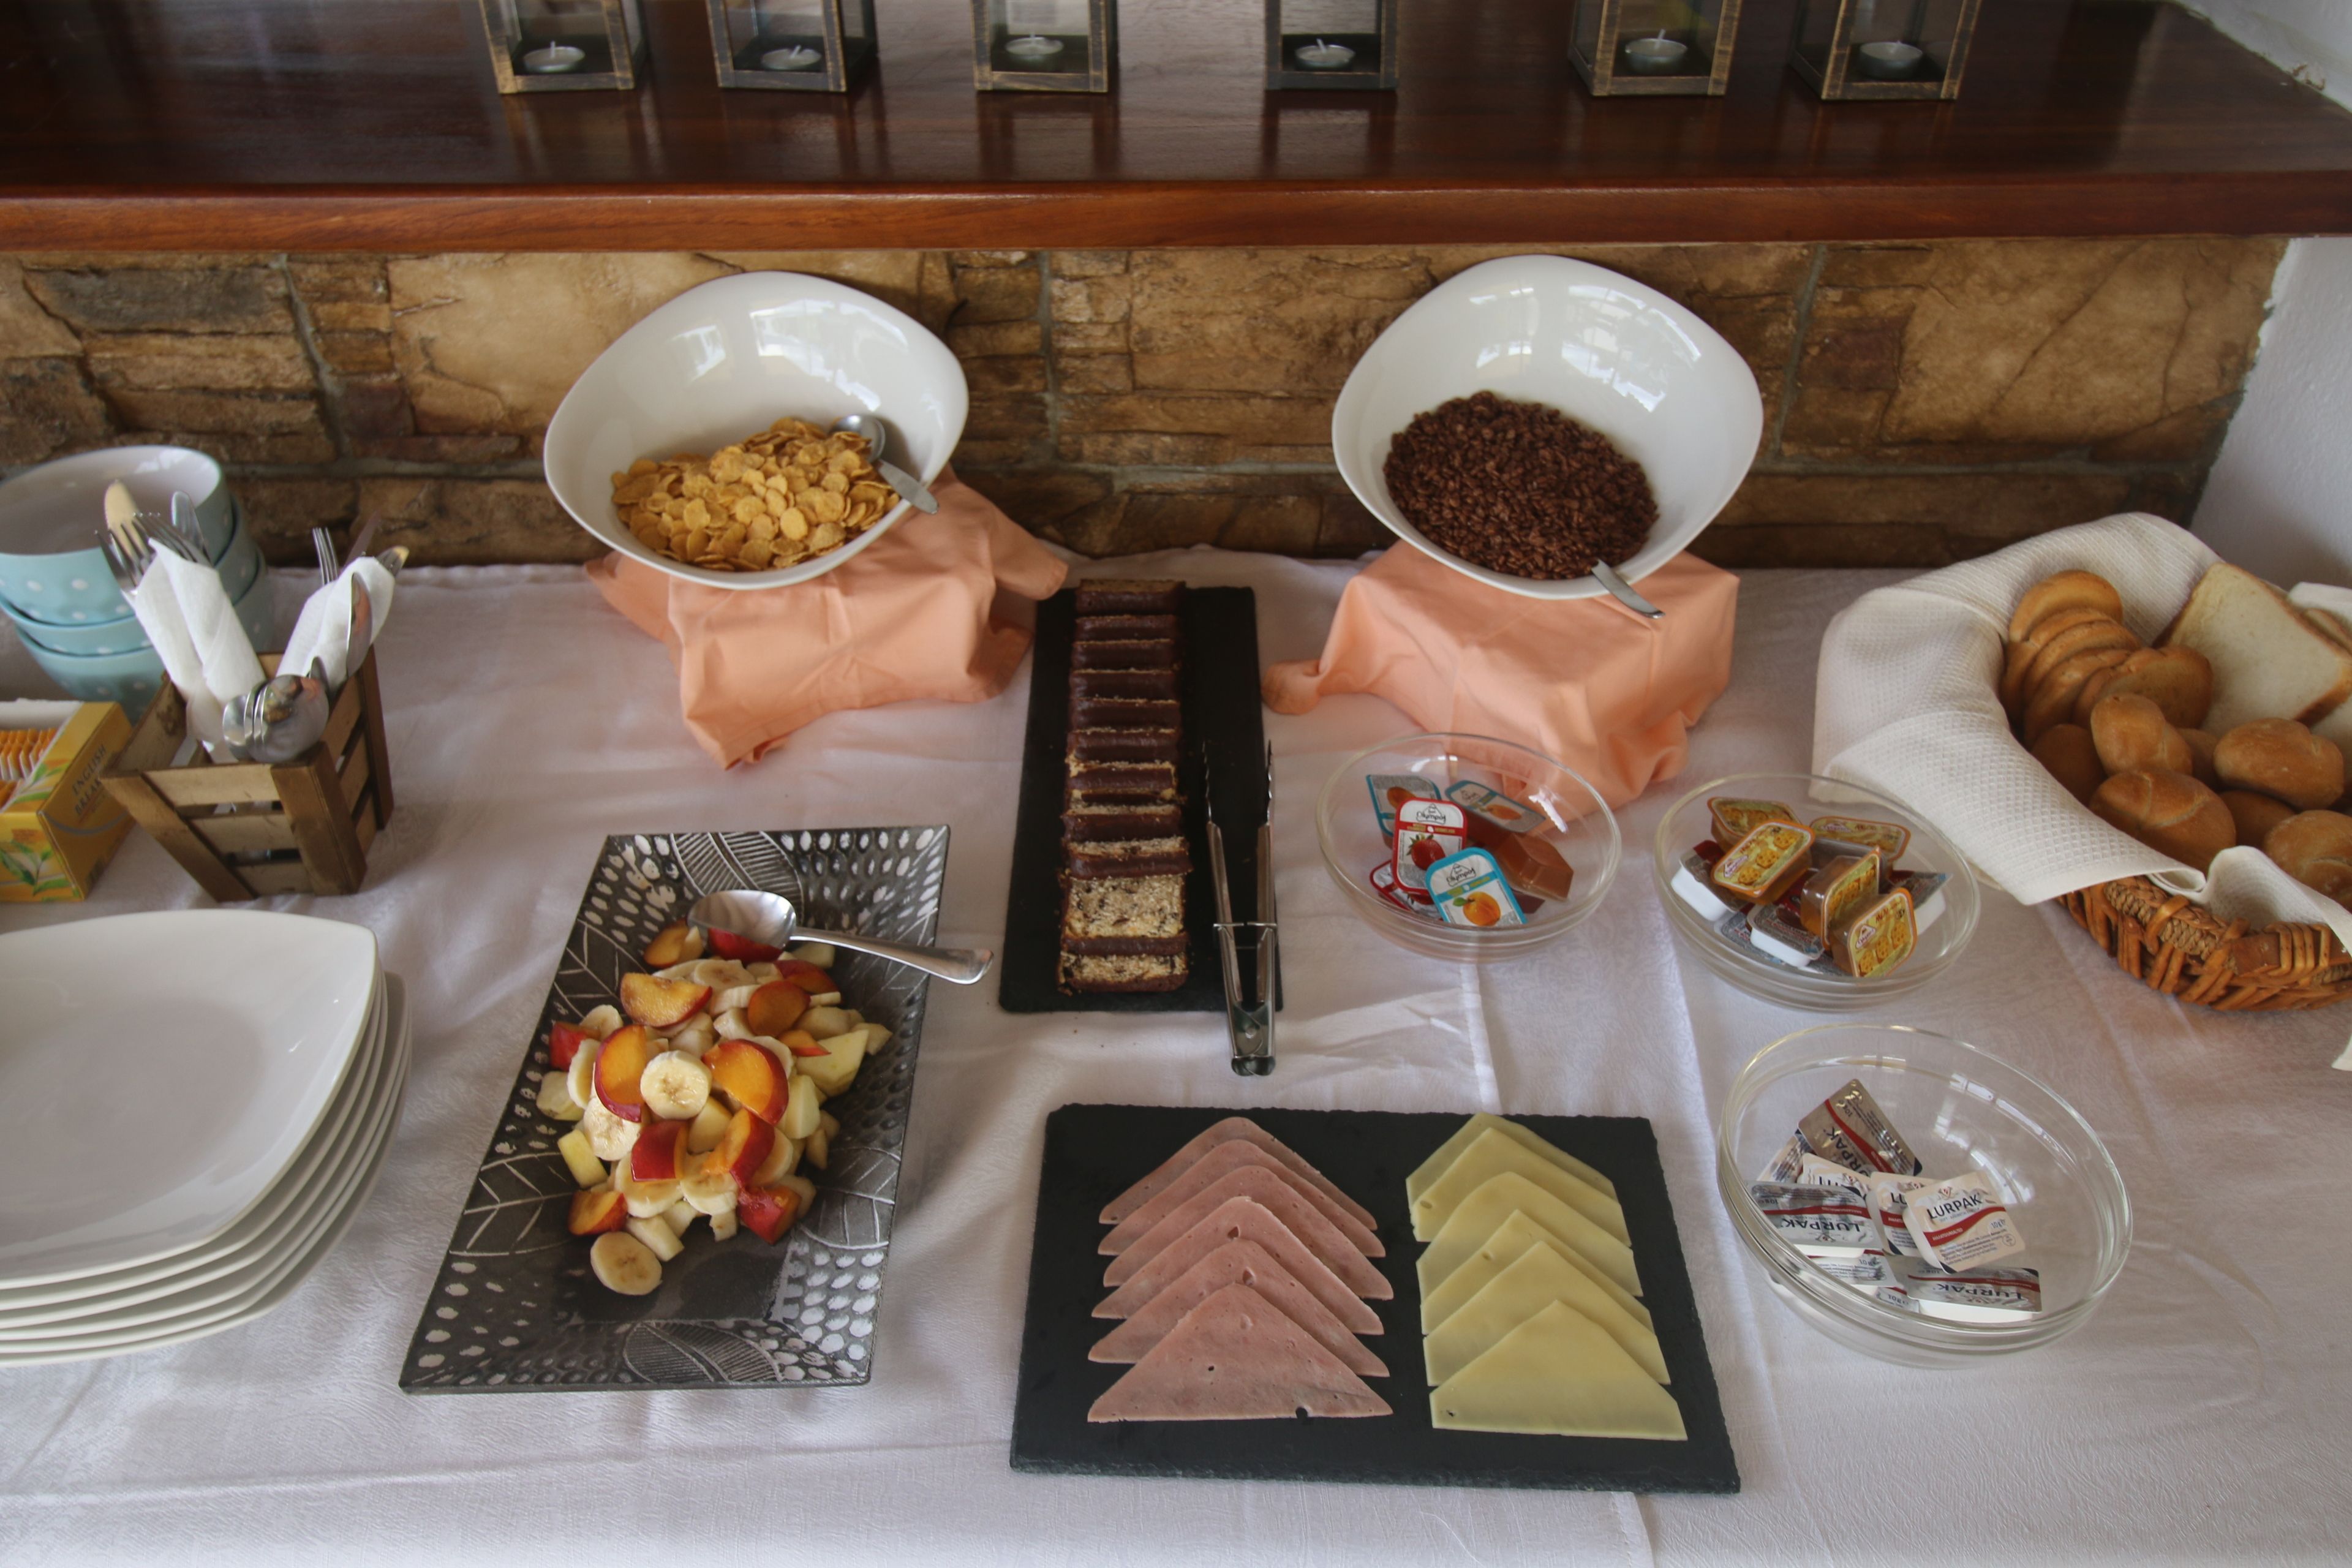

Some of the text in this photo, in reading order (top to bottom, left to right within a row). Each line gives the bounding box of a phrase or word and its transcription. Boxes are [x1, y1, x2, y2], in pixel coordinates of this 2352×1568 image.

[72, 744, 106, 794] ENGLISH
[75, 777, 102, 815] BREAK
[1927, 1194, 1982, 1220] LURPAK
[1781, 1218, 1861, 1232] LURPAK
[1936, 1283, 2022, 1300] LURPAK
